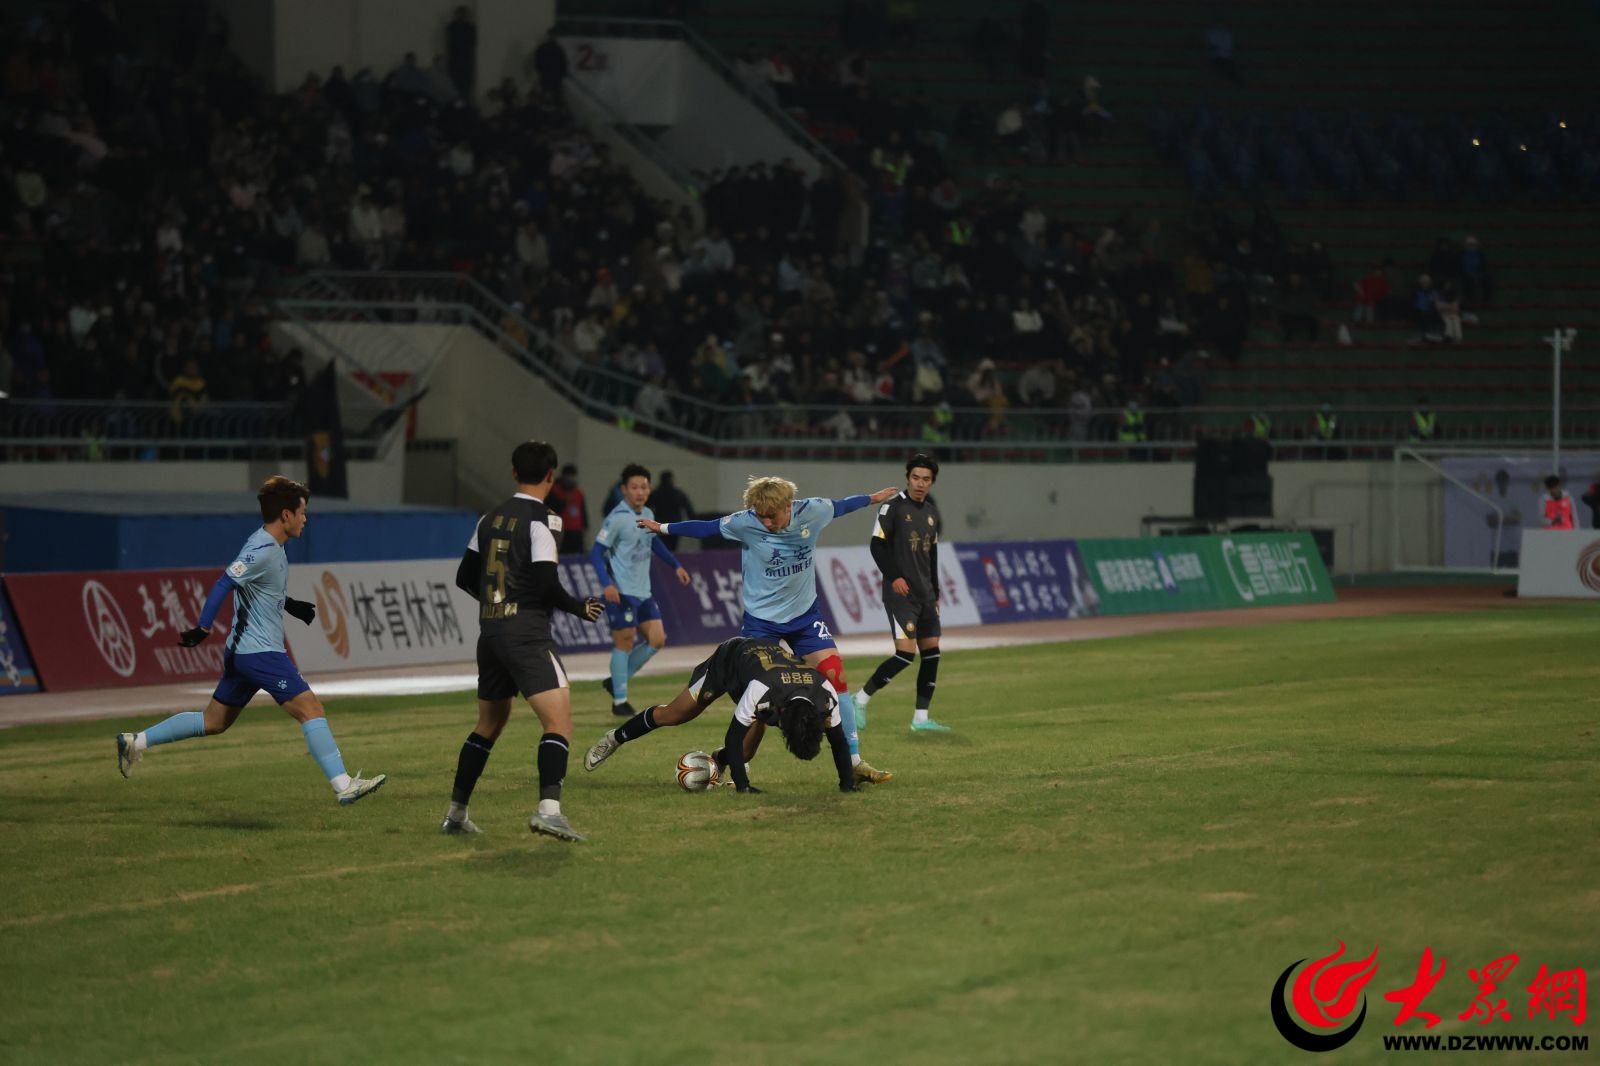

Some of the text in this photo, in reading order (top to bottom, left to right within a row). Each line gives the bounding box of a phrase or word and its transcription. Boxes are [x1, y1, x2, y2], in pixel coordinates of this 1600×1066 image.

[486, 538, 512, 603] 5
[349, 580, 465, 650] 体育休闲
